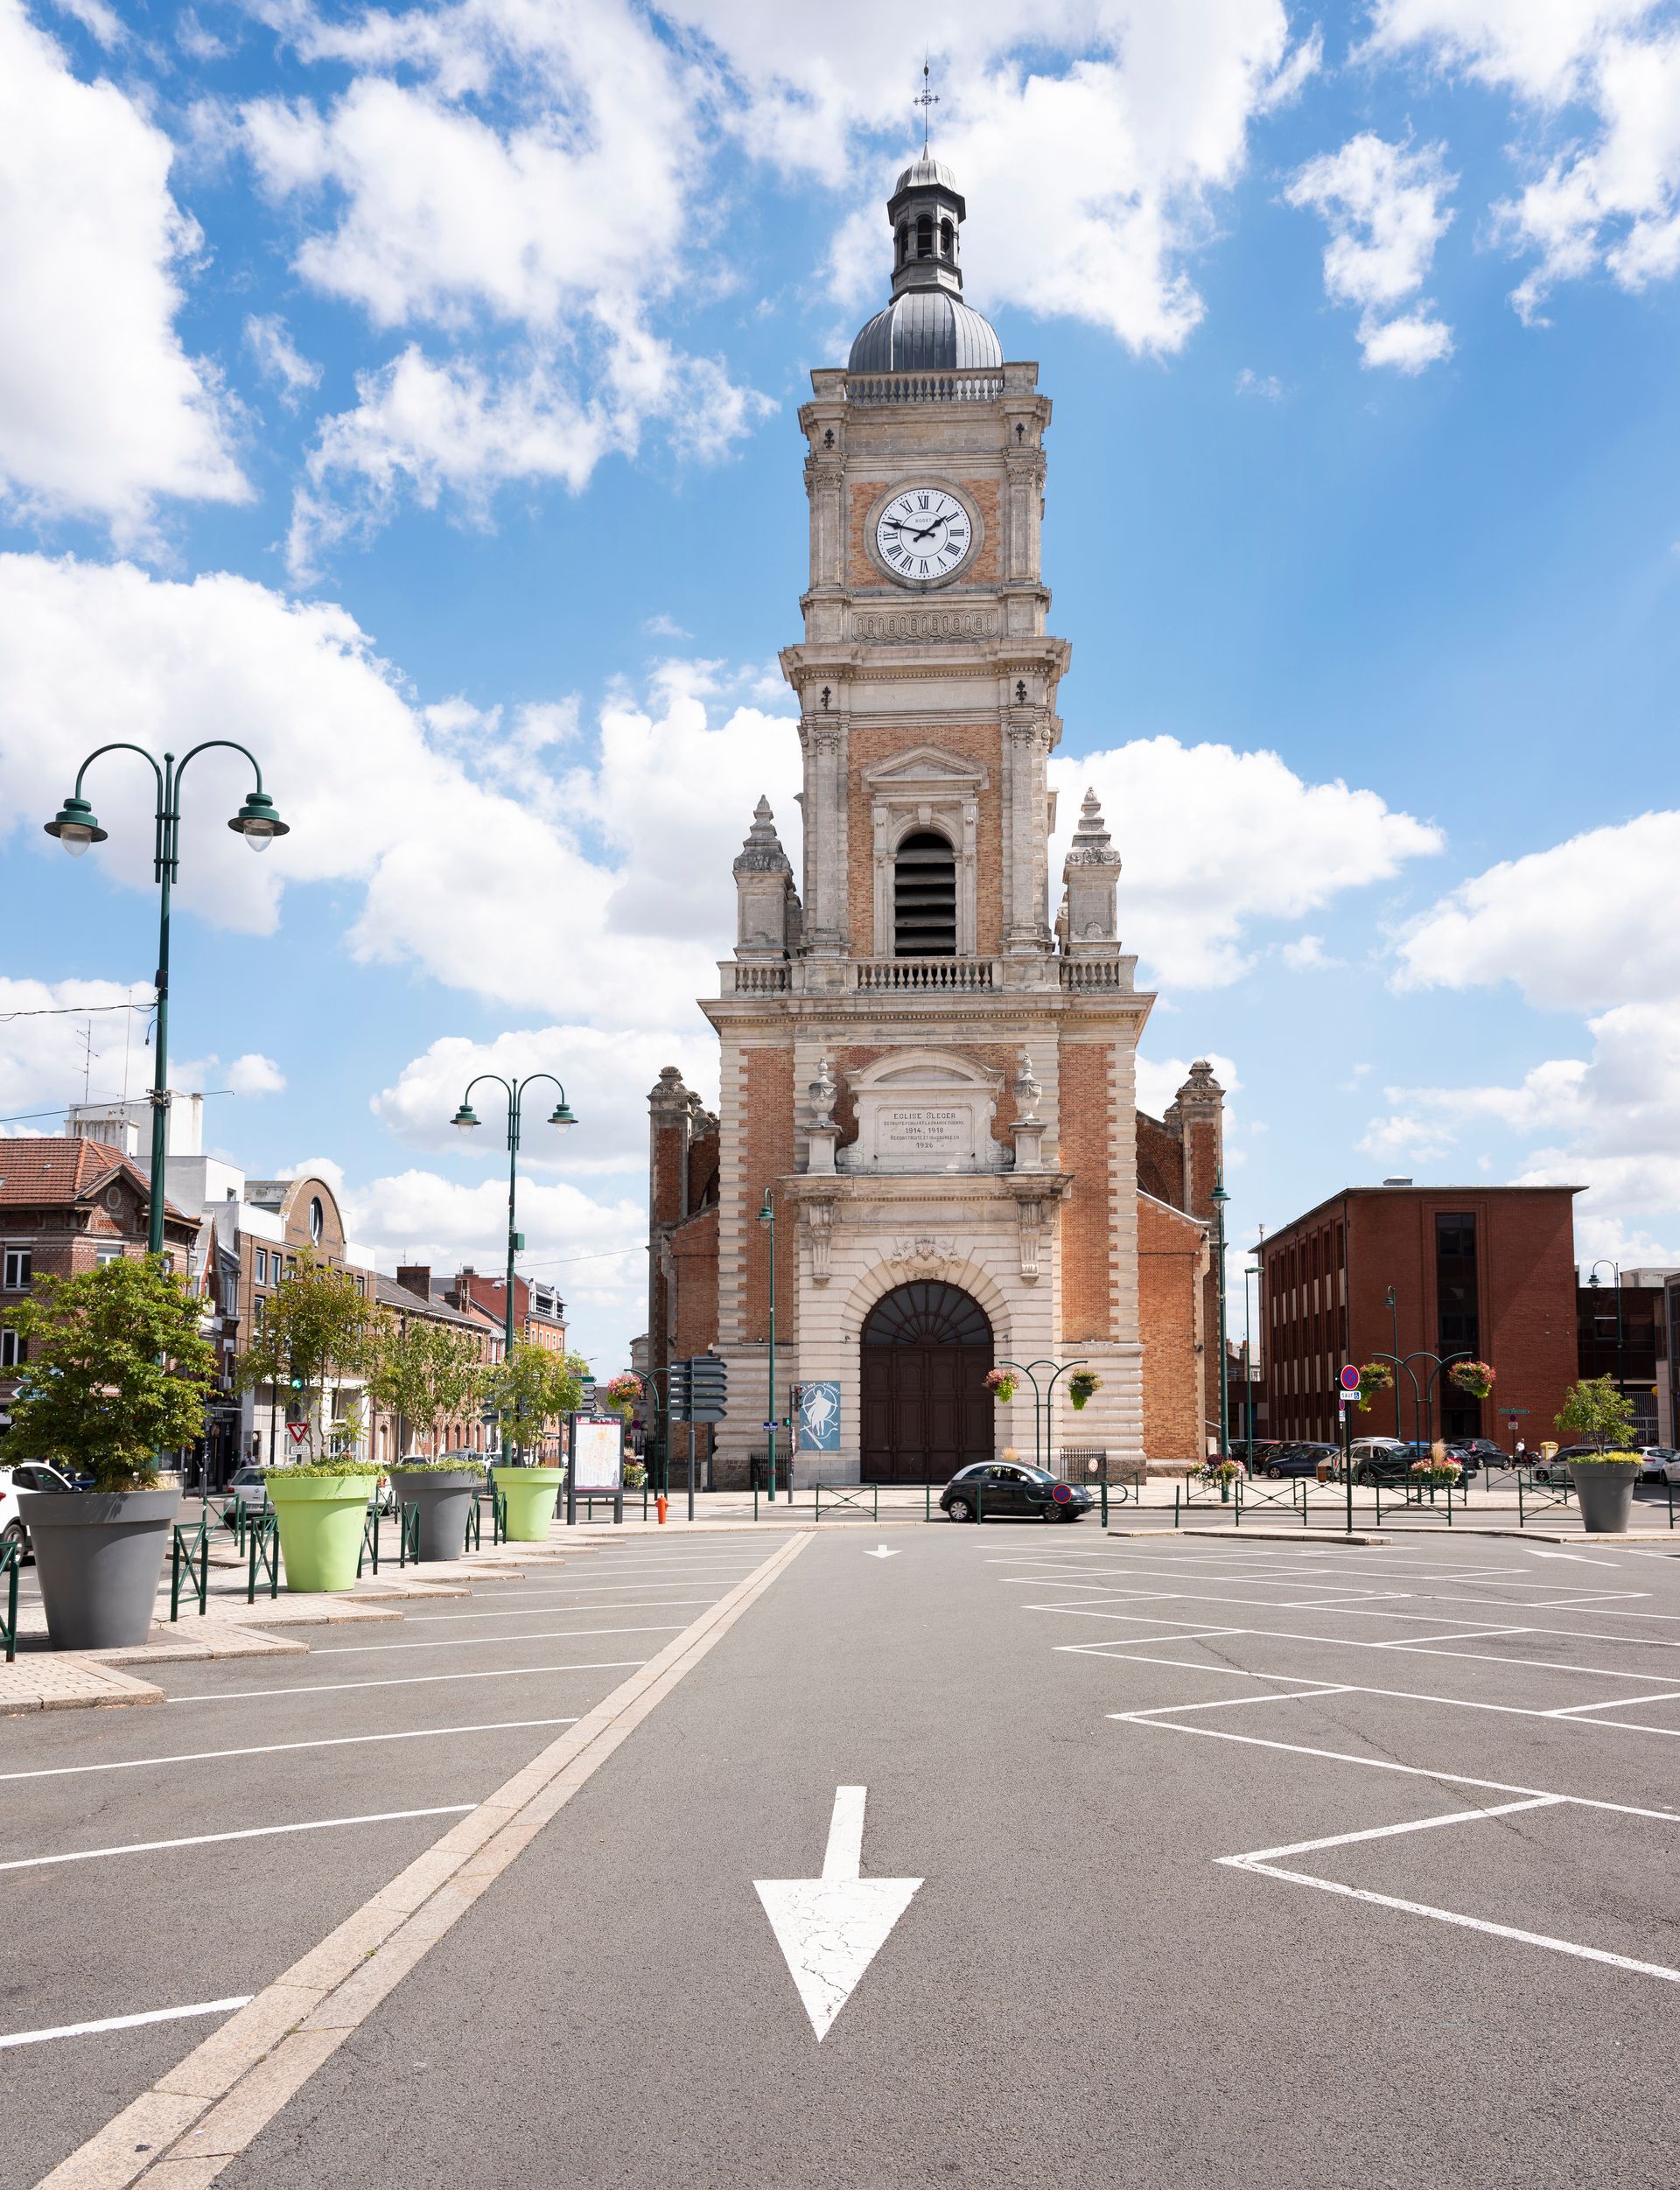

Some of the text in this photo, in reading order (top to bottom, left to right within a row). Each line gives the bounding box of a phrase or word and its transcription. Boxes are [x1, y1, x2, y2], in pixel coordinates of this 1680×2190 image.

[900, 500, 914, 515] XI
[917, 495, 929, 510] XII
[935, 500, 945, 513] I
[946, 511, 959, 522] II
[884, 530, 898, 540] IX
[886, 544, 904, 561] VIII
[900, 556, 914, 571] VII
[920, 559, 929, 573] VI
[937, 556, 947, 569] V
